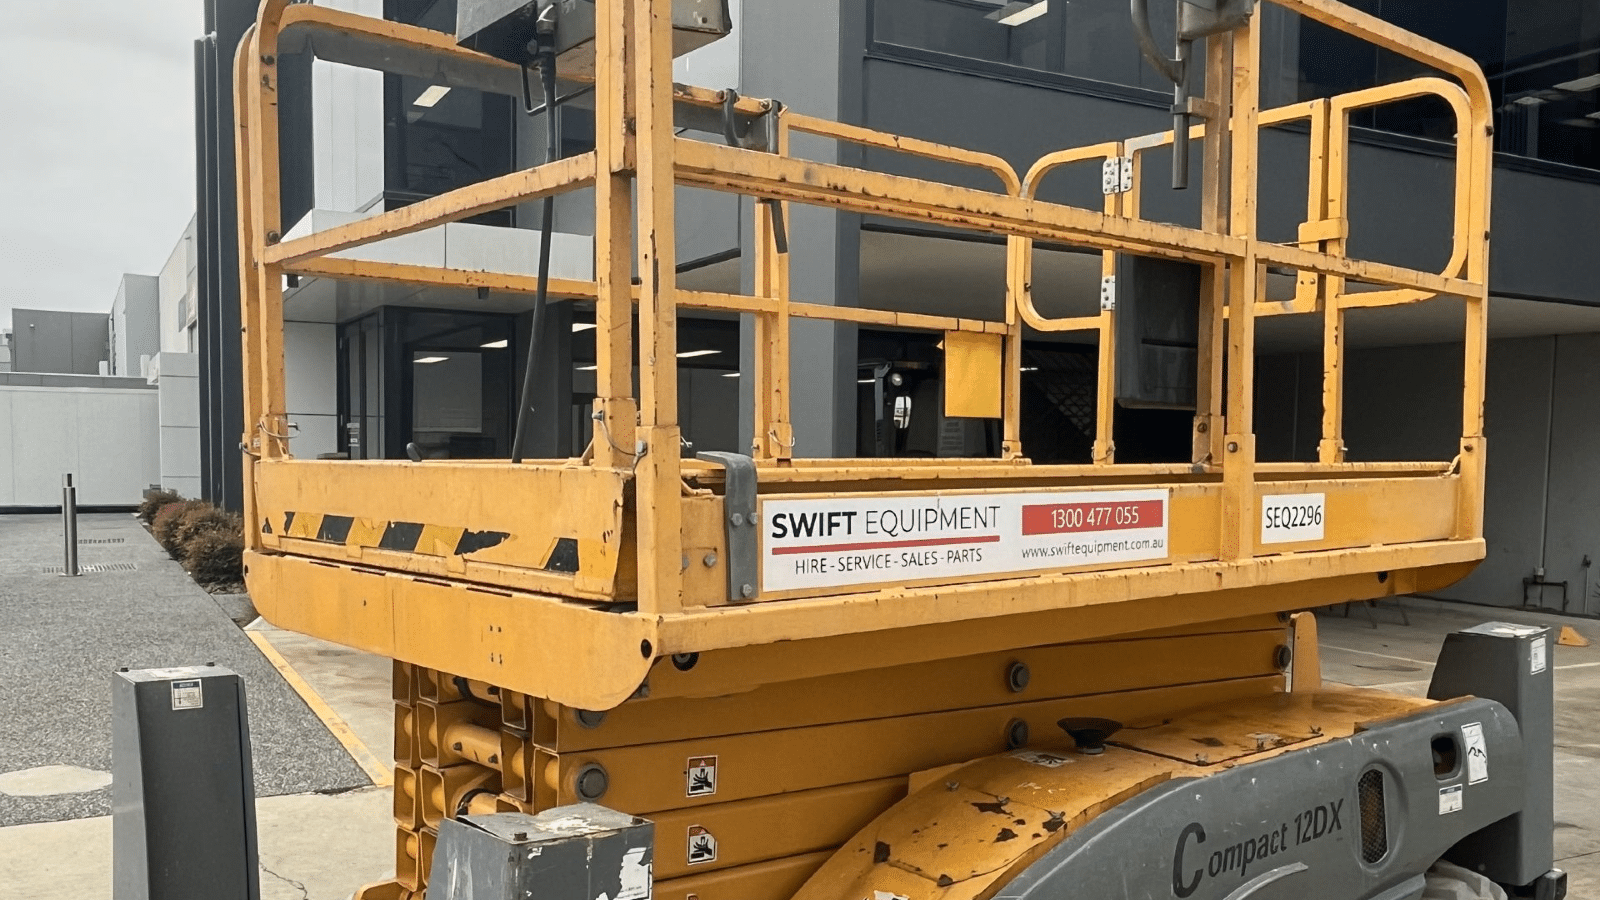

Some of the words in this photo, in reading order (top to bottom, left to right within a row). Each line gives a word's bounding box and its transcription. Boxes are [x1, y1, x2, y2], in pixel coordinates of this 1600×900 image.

[772, 511, 857, 538] SWIFT
[866, 506, 1000, 537] EQUIPMENT
[1051, 508, 1083, 528] 1300
[1086, 507, 1112, 527] 477
[1115, 506, 1139, 525] 055
[1266, 505, 1322, 530] SEQ2296
[1021, 538, 1164, 559] www.swiftequipment.com.au
[1172, 822, 1288, 899] Compact
[1294, 798, 1344, 846] 12DX
